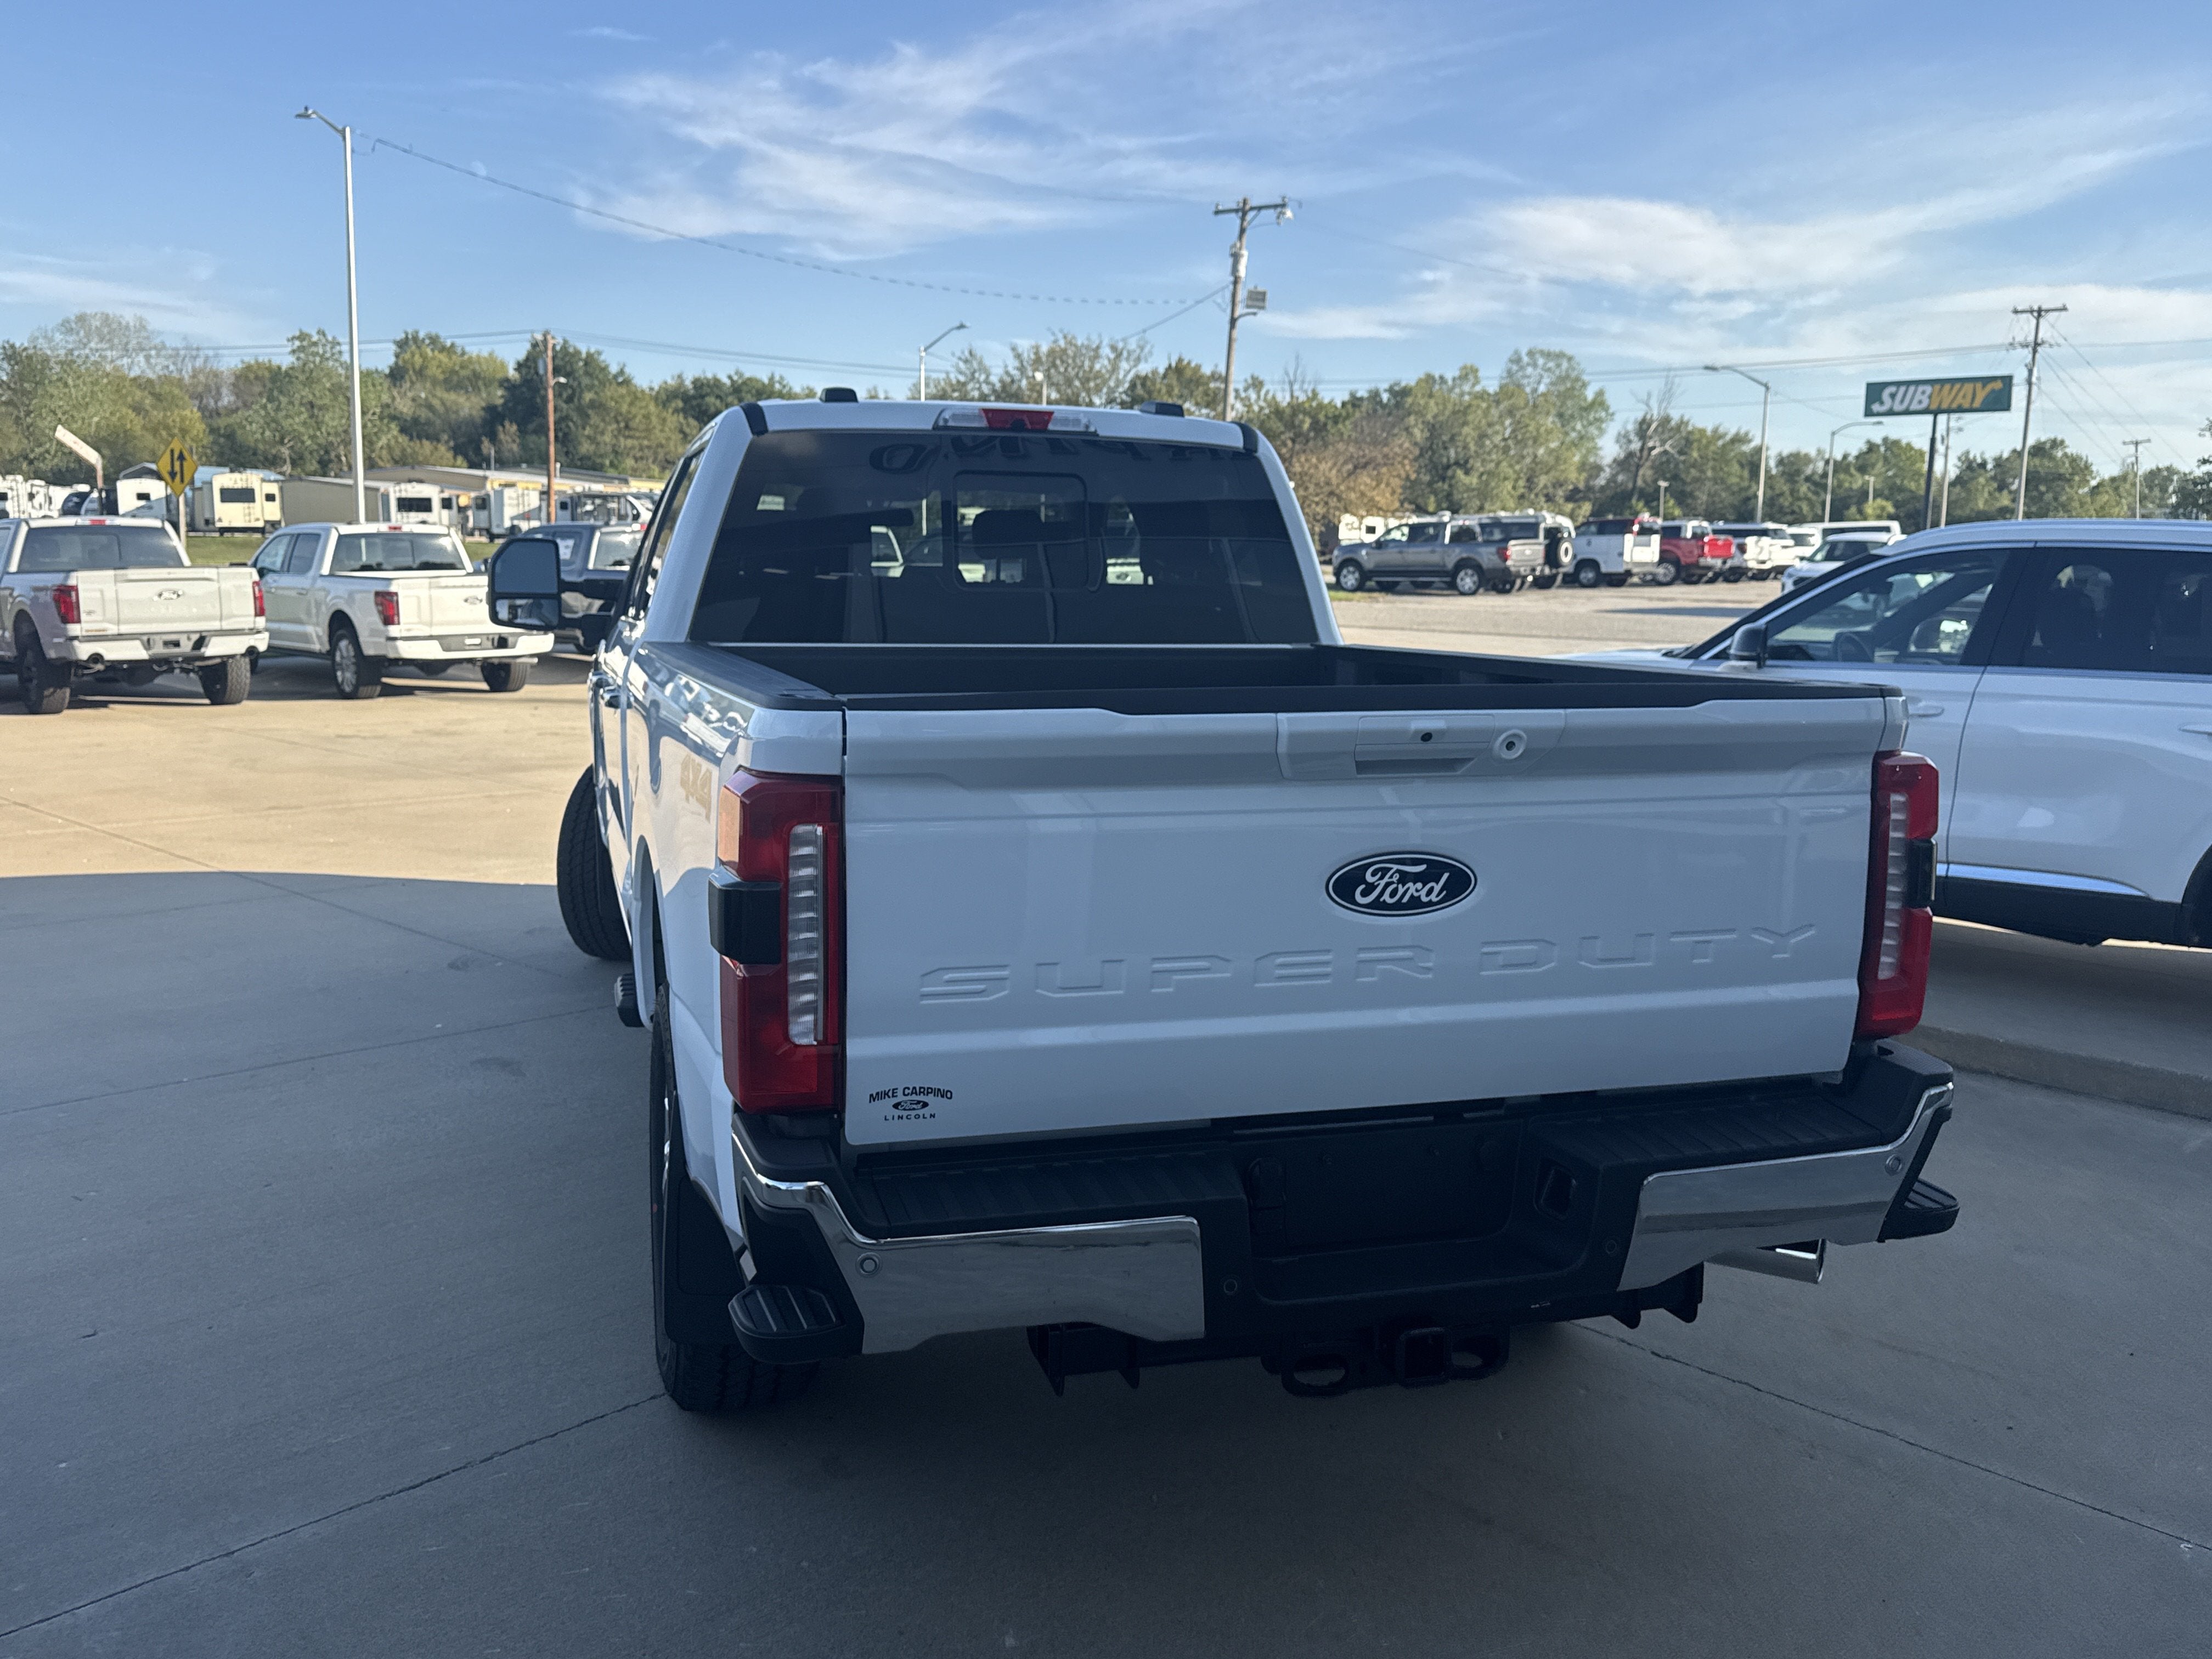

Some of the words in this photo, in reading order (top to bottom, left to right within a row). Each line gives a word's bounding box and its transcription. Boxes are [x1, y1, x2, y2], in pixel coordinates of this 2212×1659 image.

[1871, 380, 2003, 412] SUBWAY
[1355, 864, 1449, 905] Ford
[920, 945, 1434, 1003] SUPER
[1481, 923, 1816, 976] DUTY
[869, 1088, 899, 1103] MIKE
[902, 1086, 953, 1099] CARPINO
[898, 1100, 923, 1109] Ford
